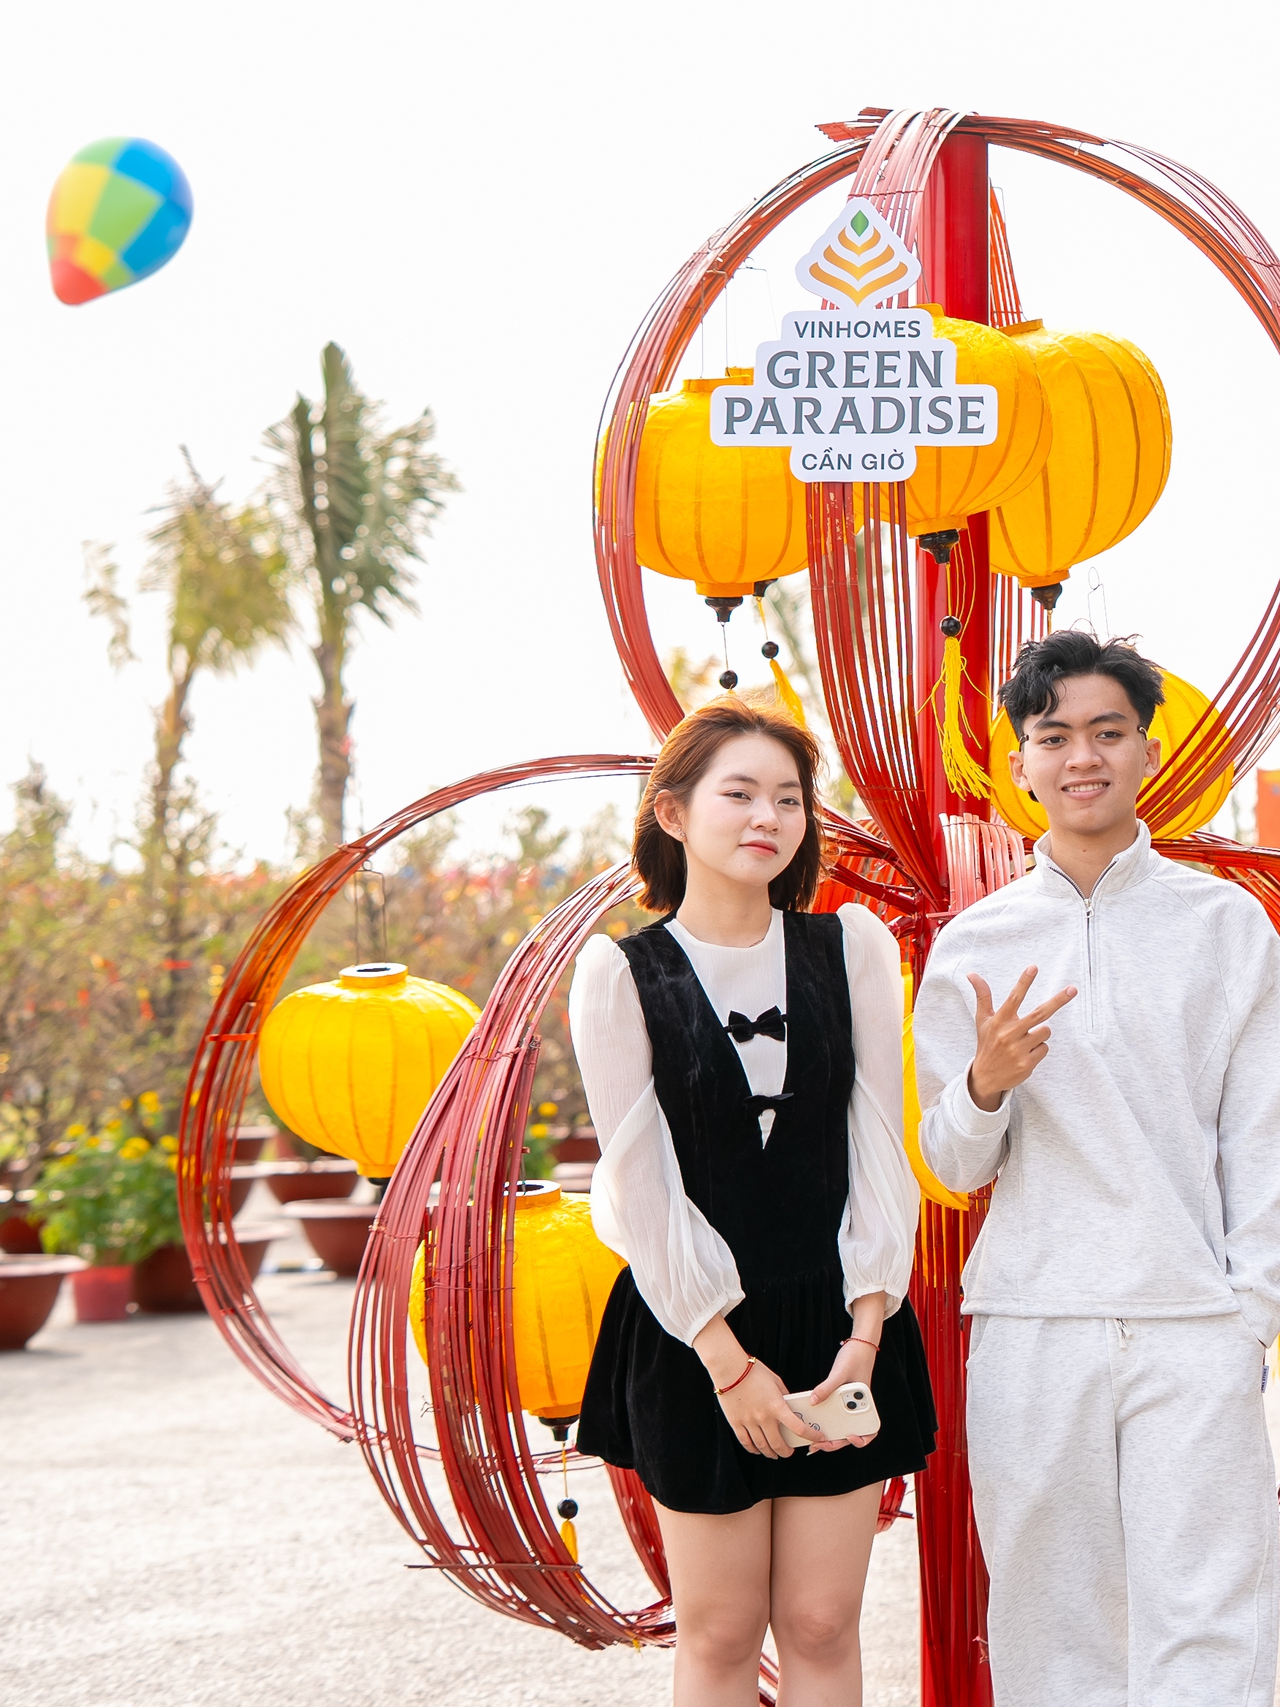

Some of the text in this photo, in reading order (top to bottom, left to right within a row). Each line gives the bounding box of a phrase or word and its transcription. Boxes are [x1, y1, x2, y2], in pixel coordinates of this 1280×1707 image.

[794, 320, 921, 338] VINHOMES
[766, 350, 944, 389] GREEN
[723, 395, 986, 435] PARADISE
[801, 446, 905, 471] CẦN GIỜ
